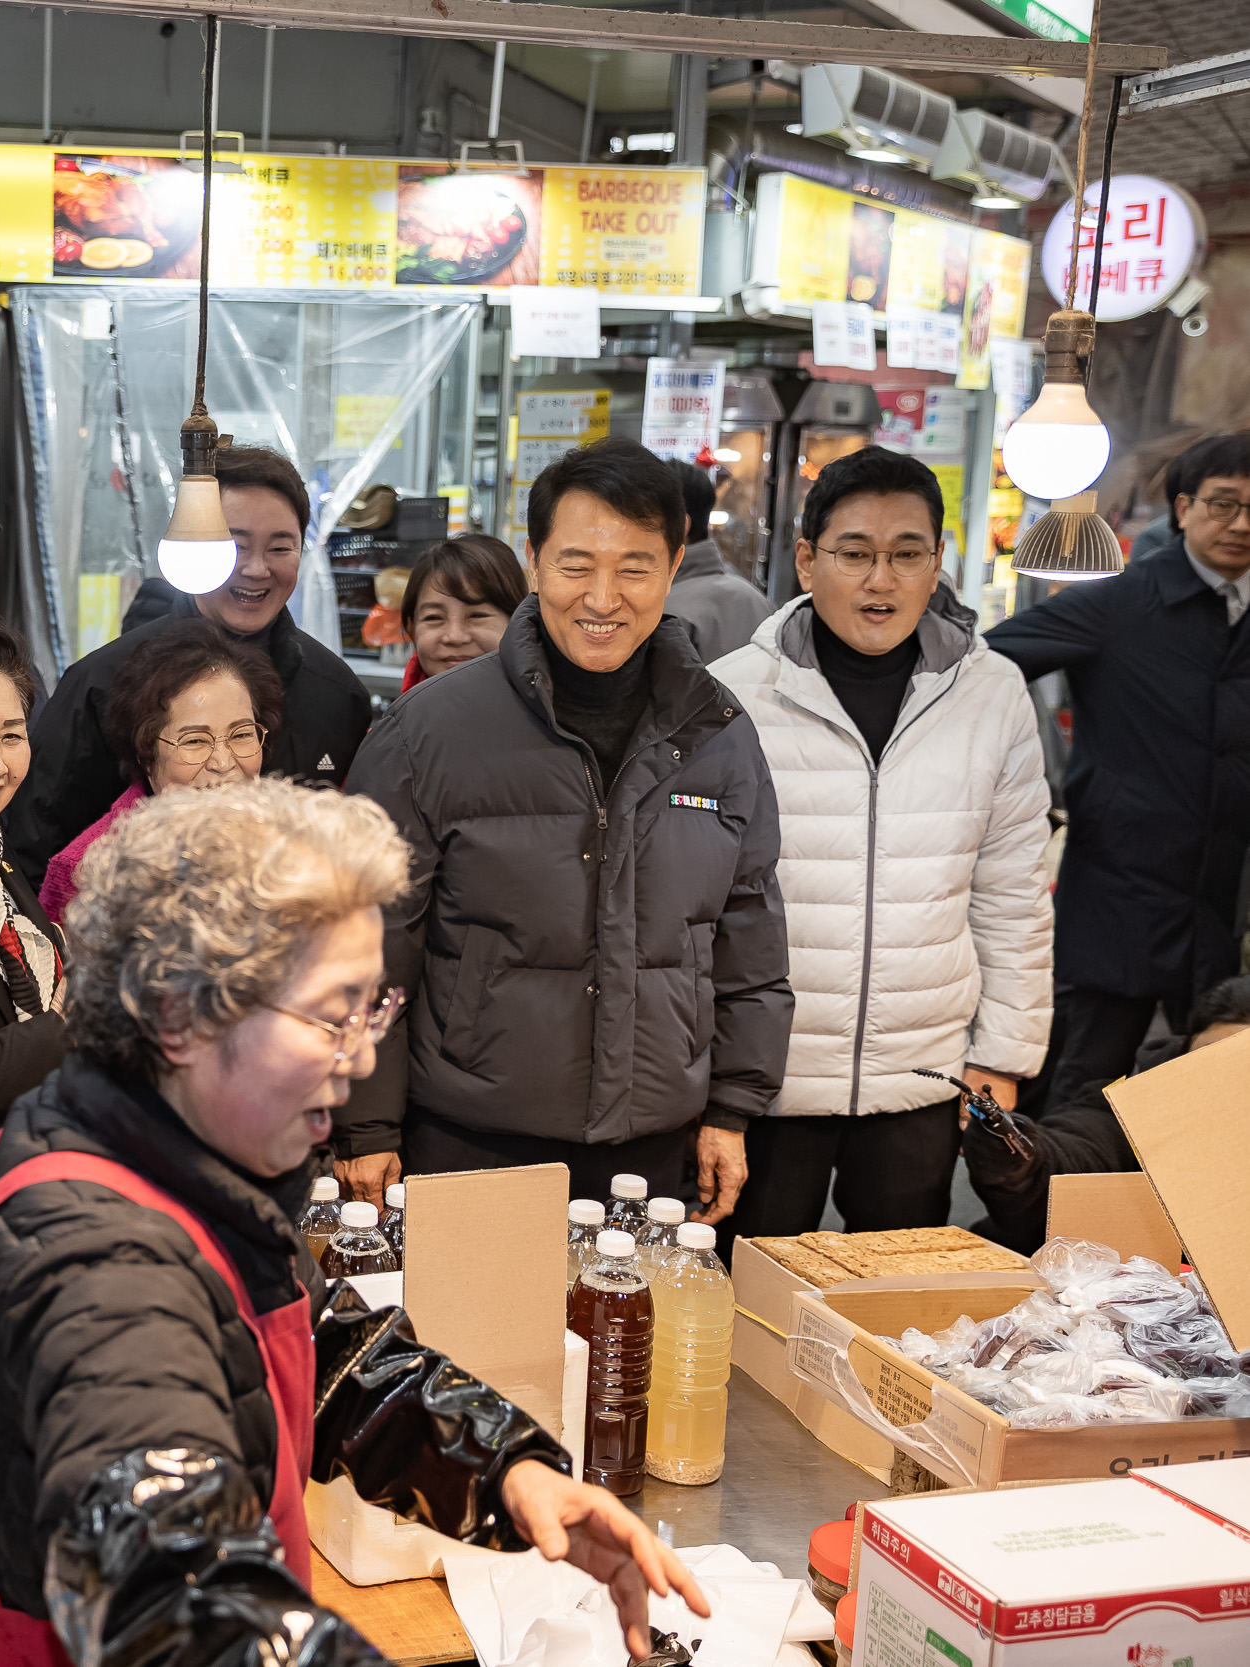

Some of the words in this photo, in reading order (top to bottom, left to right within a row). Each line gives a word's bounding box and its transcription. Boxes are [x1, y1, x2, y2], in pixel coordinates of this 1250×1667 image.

[578, 178, 683, 205] BARBEQUE
[581, 210, 626, 234] TAKE
[636, 212, 678, 236] OUT
[1069, 197, 1166, 248] 오리
[869, 1520, 911, 1564] 취급주의
[1014, 1603, 1097, 1632] 고추장담금용
